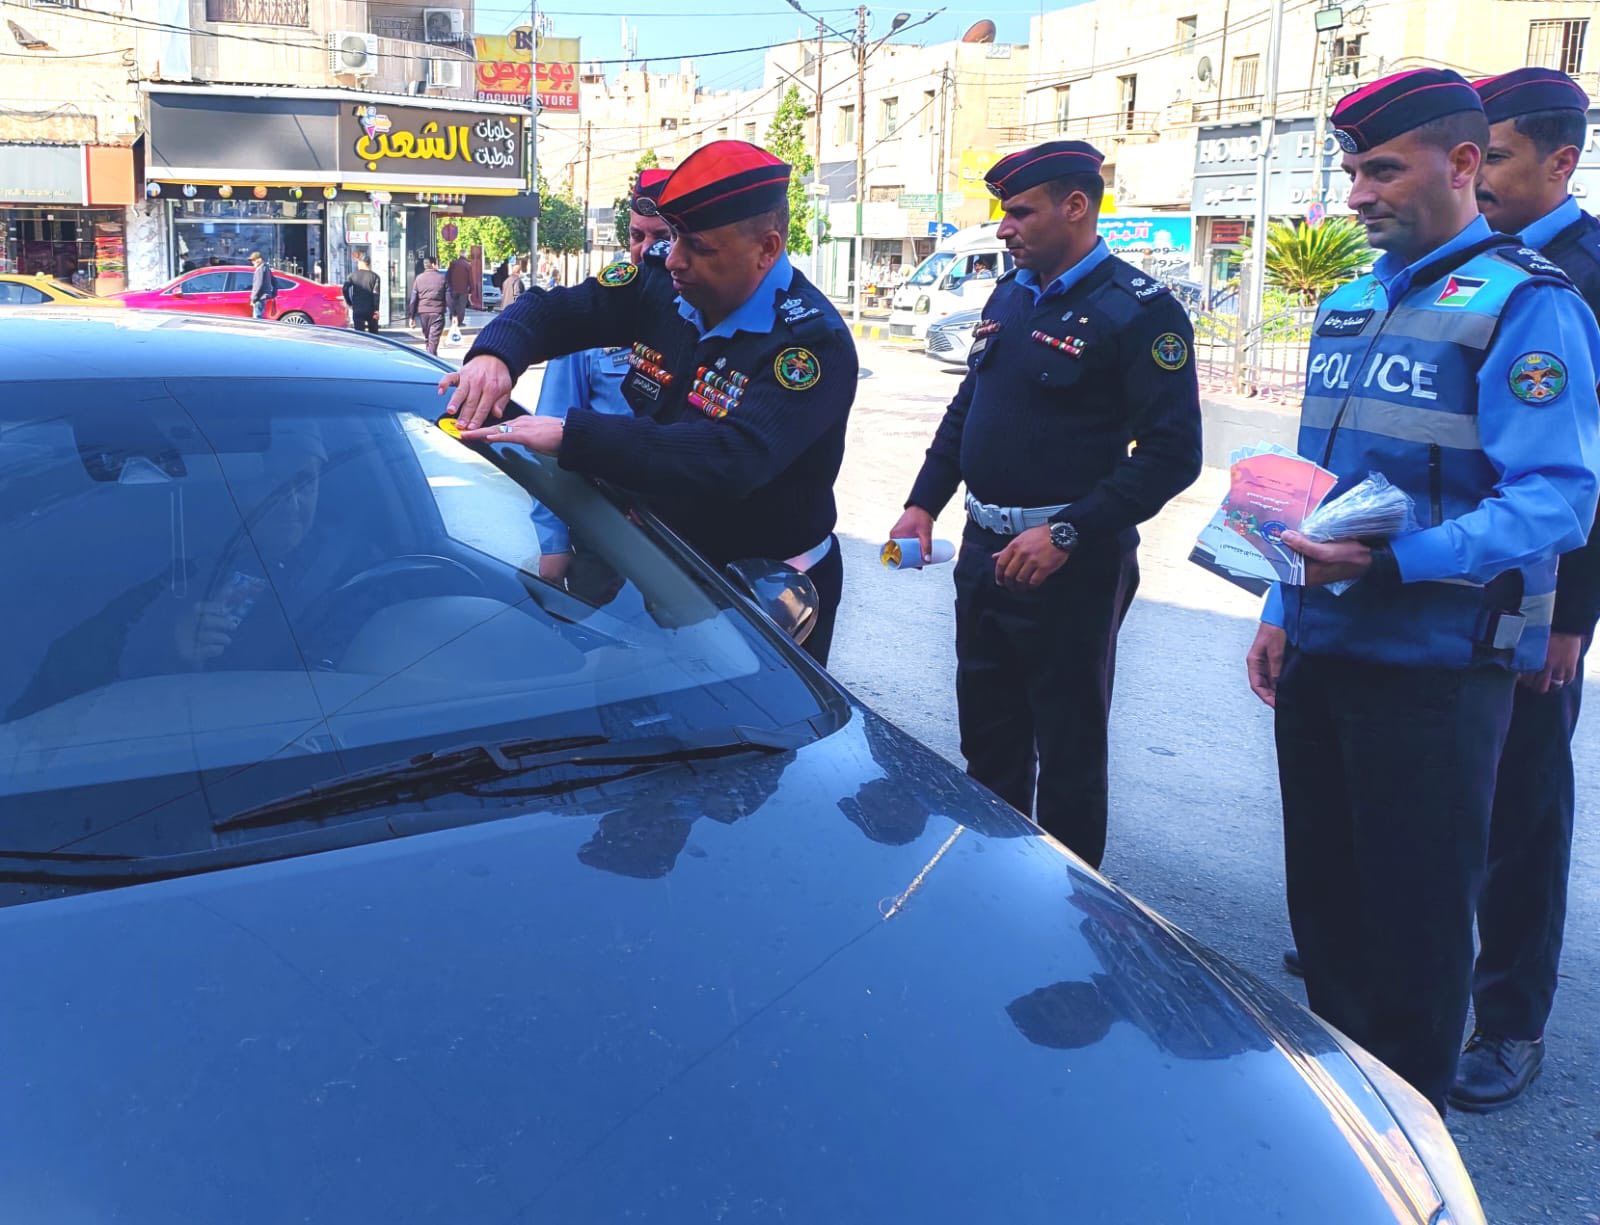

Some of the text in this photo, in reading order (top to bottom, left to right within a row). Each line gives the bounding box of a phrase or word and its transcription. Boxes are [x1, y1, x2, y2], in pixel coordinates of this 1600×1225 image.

[538, 94, 574, 107] STORE
[476, 118, 514, 142] حلويات
[355, 121, 473, 171] الشعب
[475, 147, 514, 169] مرطبات
[1307, 352, 1438, 400] POLICE
